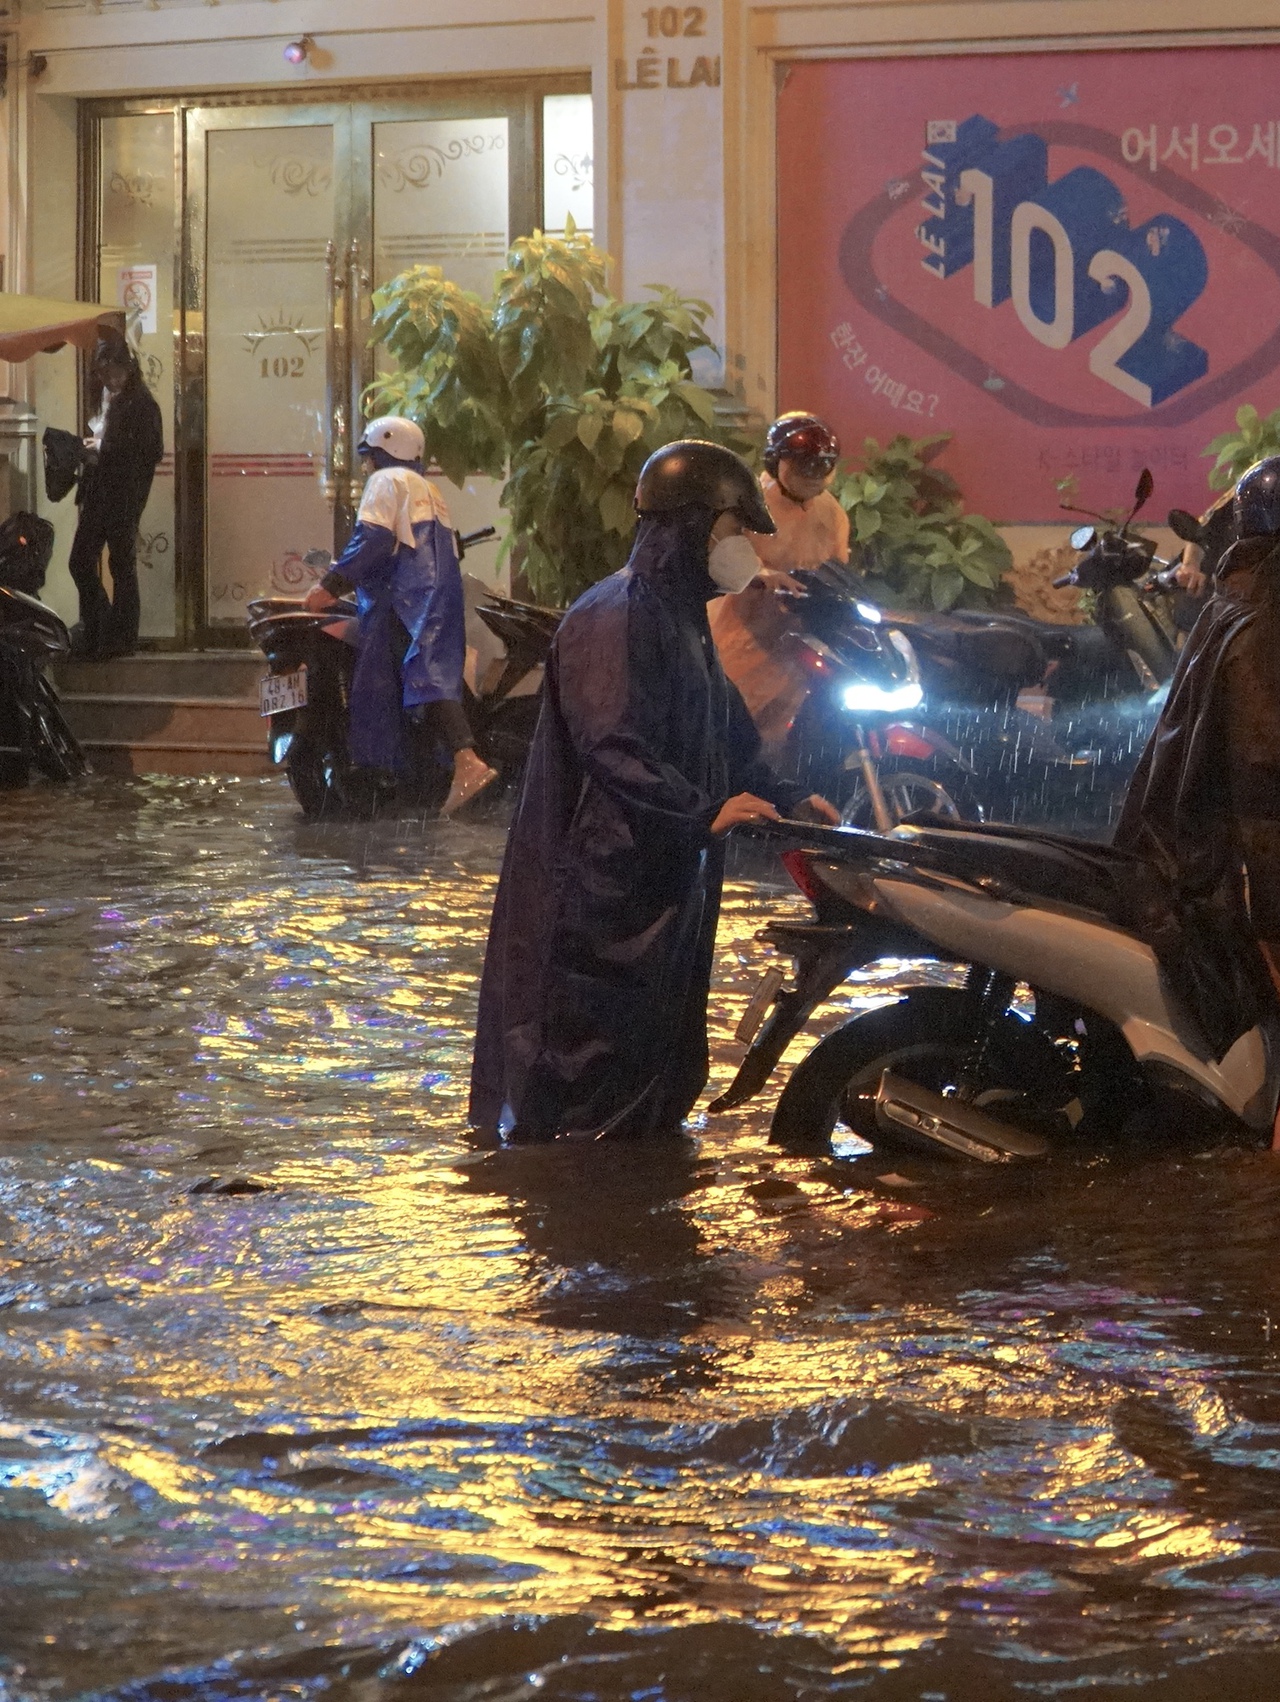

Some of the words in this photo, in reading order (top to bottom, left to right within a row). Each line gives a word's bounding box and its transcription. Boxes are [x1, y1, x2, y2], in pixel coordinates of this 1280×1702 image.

[641, 6, 706, 38] 102
[614, 46, 661, 91] LÊ
[666, 56, 721, 88] LAI
[920, 150, 946, 220] LAI
[916, 225, 946, 280] LÊ
[955, 167, 1152, 408] 102
[261, 357, 305, 378] 102
[829, 322, 868, 371] 한잔
[864, 364, 940, 418] 어때요?
